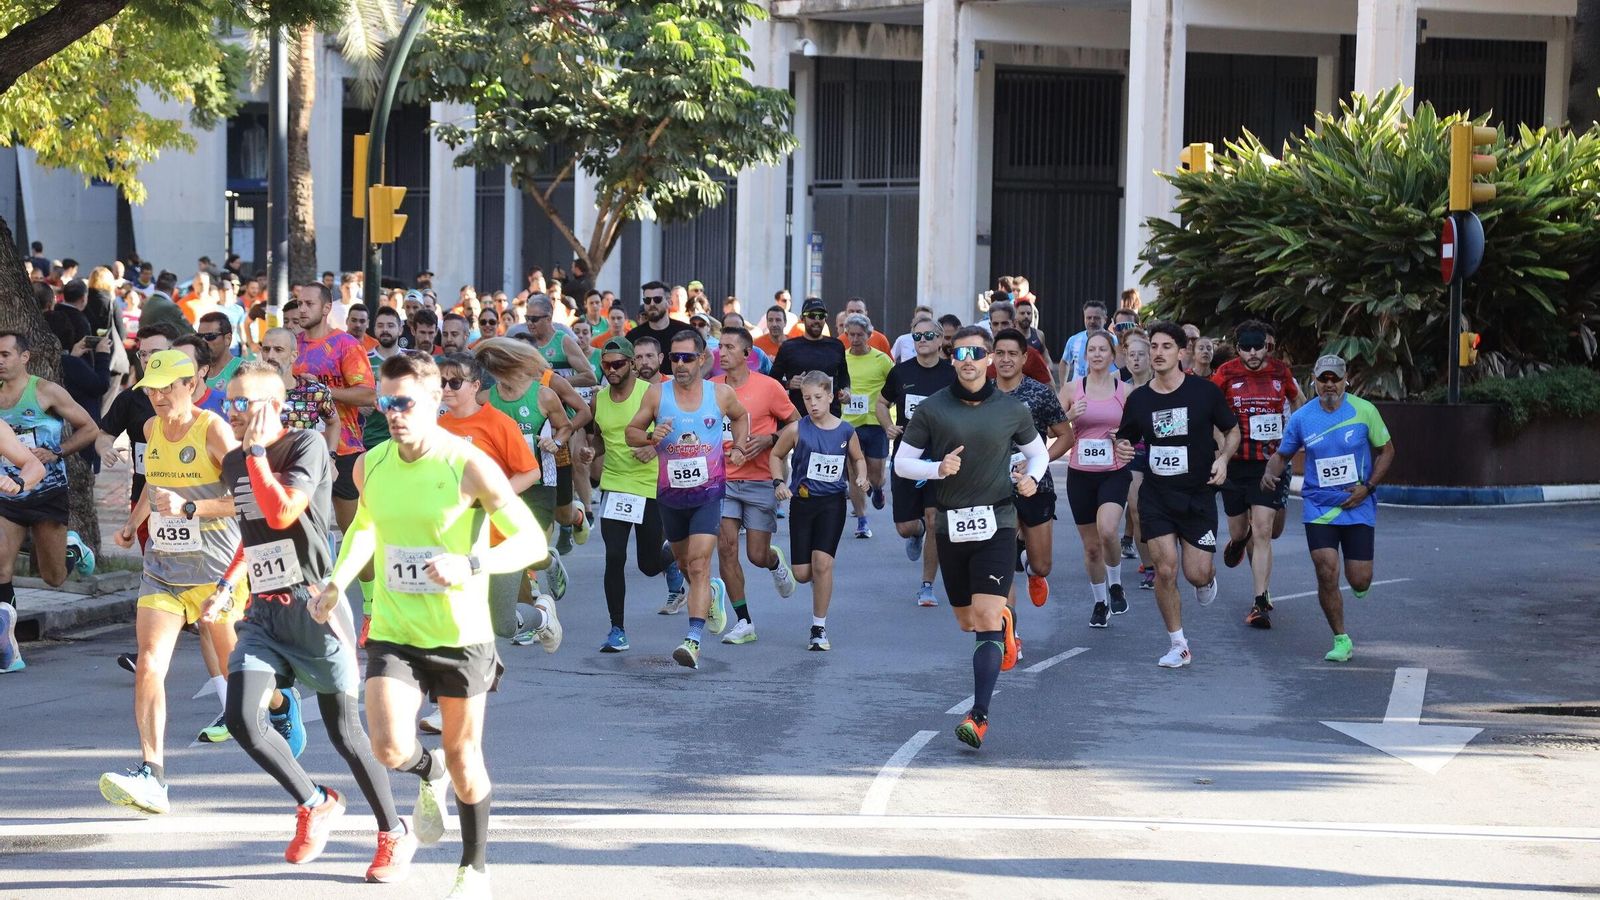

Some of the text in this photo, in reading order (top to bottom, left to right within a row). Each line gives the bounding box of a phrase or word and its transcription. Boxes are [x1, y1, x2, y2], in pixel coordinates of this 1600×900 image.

[1256, 423, 1278, 433] 152
[1084, 448, 1106, 457] 984
[1154, 457, 1180, 467] 742
[673, 468, 701, 480] 584
[815, 463, 839, 475] 112
[1323, 465, 1348, 478] 937
[615, 502, 633, 513] 53
[956, 518, 987, 532] 843
[156, 527, 190, 541] 439
[252, 557, 286, 578] 811
